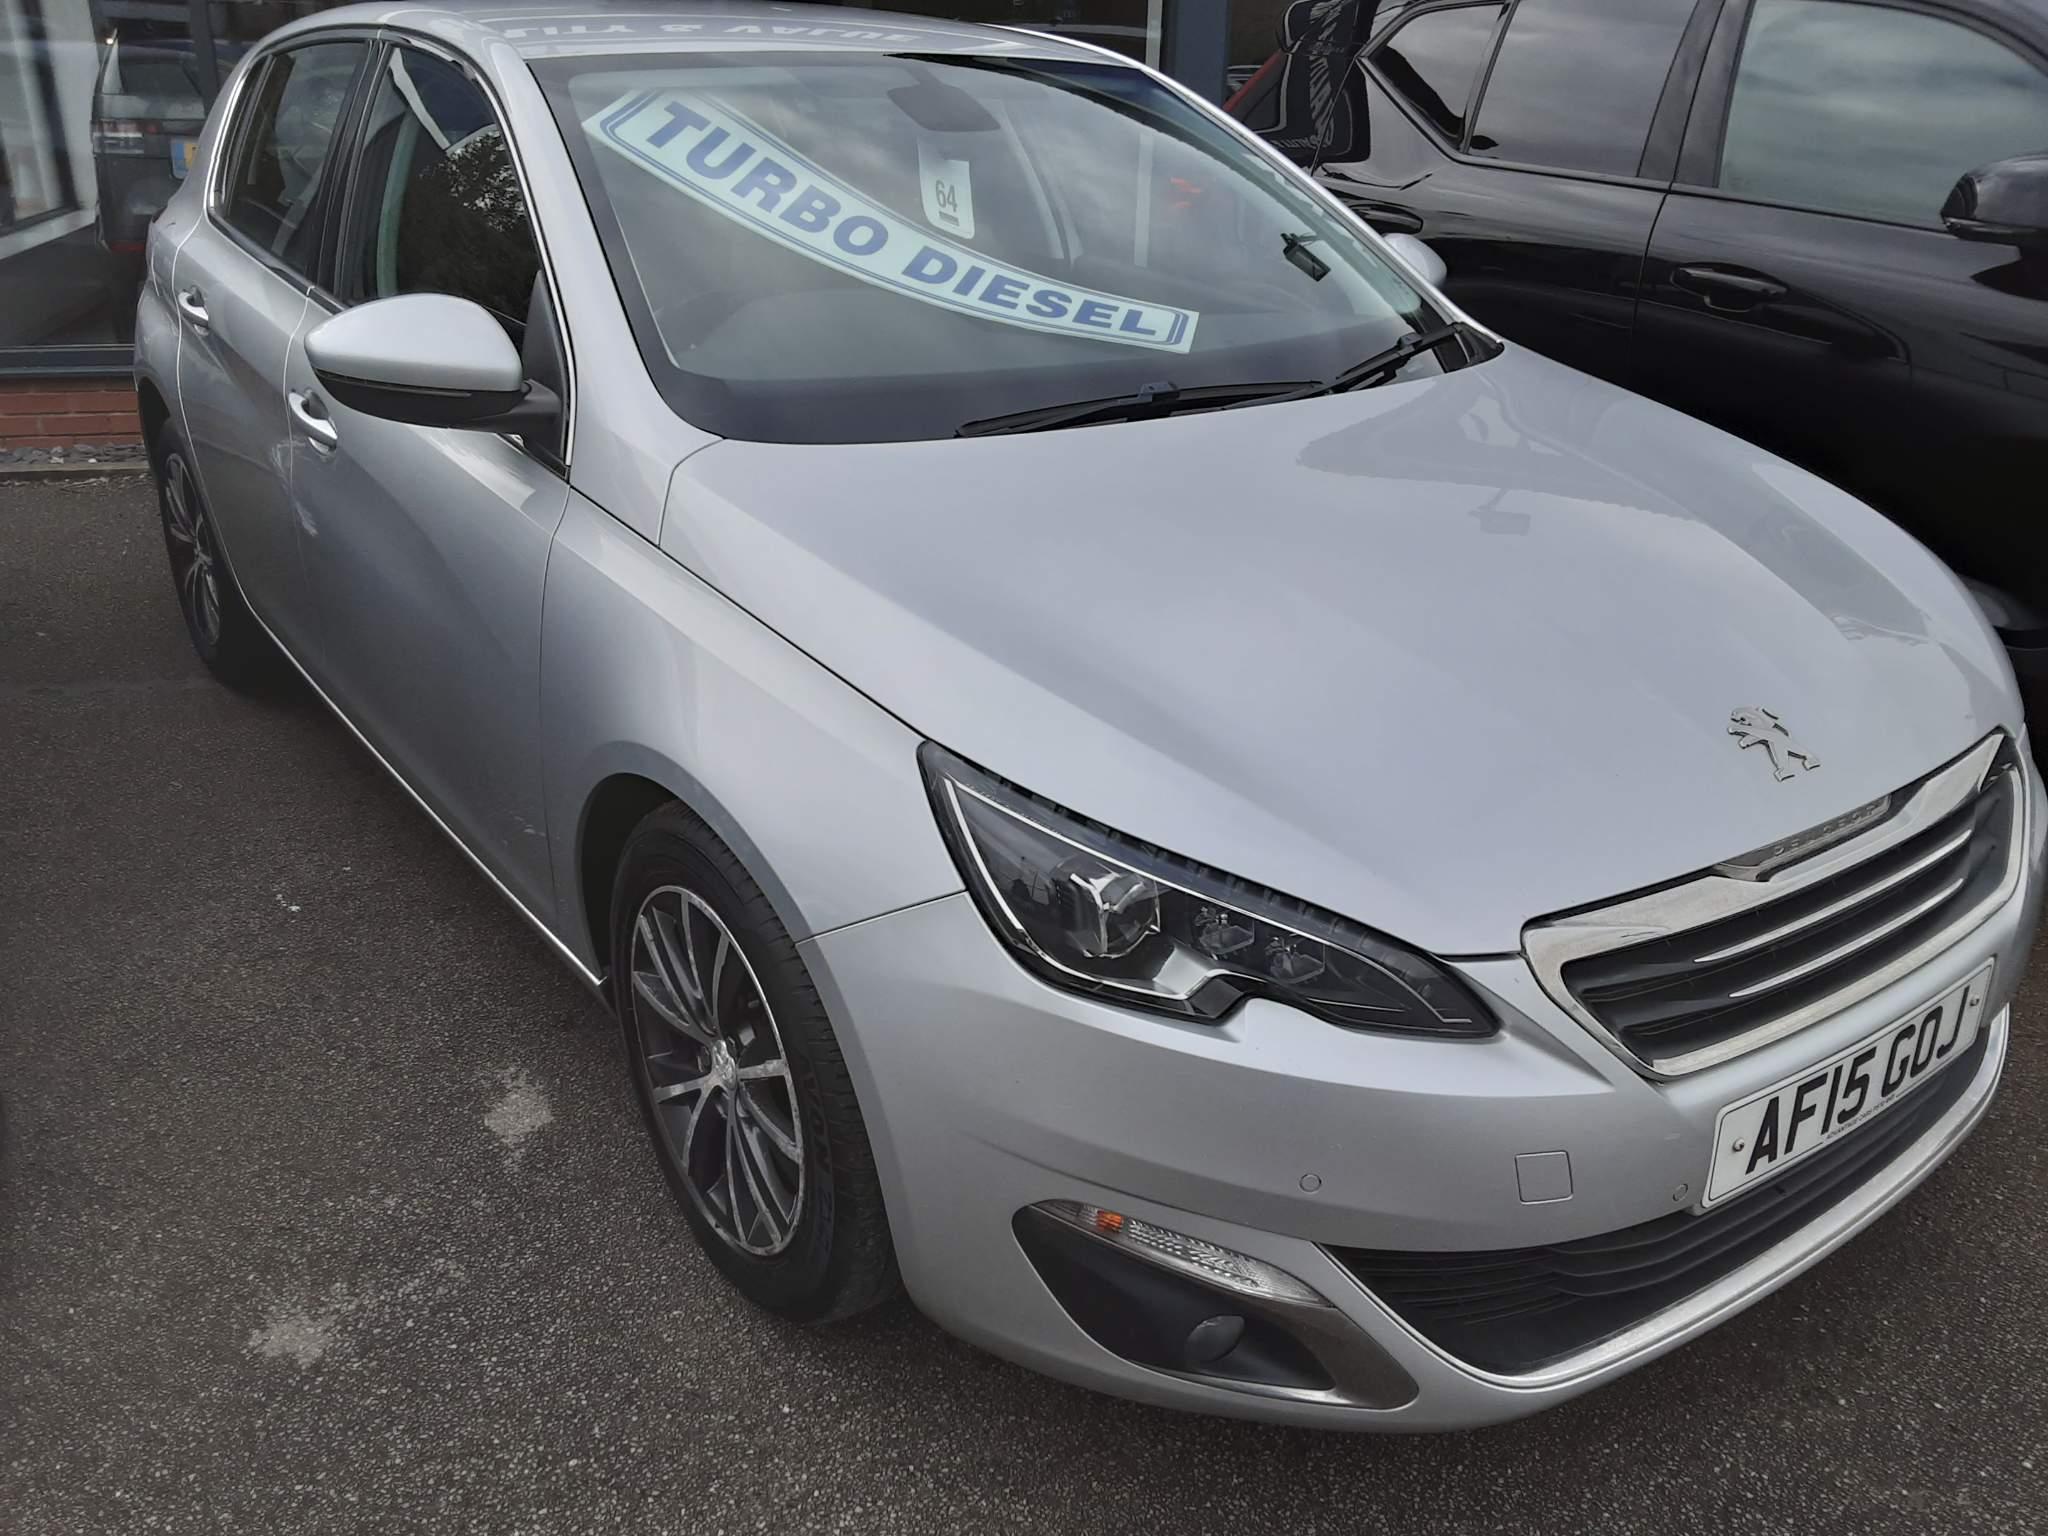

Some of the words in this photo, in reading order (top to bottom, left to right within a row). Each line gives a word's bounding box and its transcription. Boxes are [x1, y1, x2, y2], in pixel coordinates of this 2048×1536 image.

[645, 101, 889, 256] TURBO
[902, 246, 1158, 336] DIESEL
[935, 179, 958, 213] 64
[1774, 803, 1879, 857] PEGEOT
[1745, 1046, 1877, 1175] AF15
[1881, 985, 1970, 1098] GOJ
